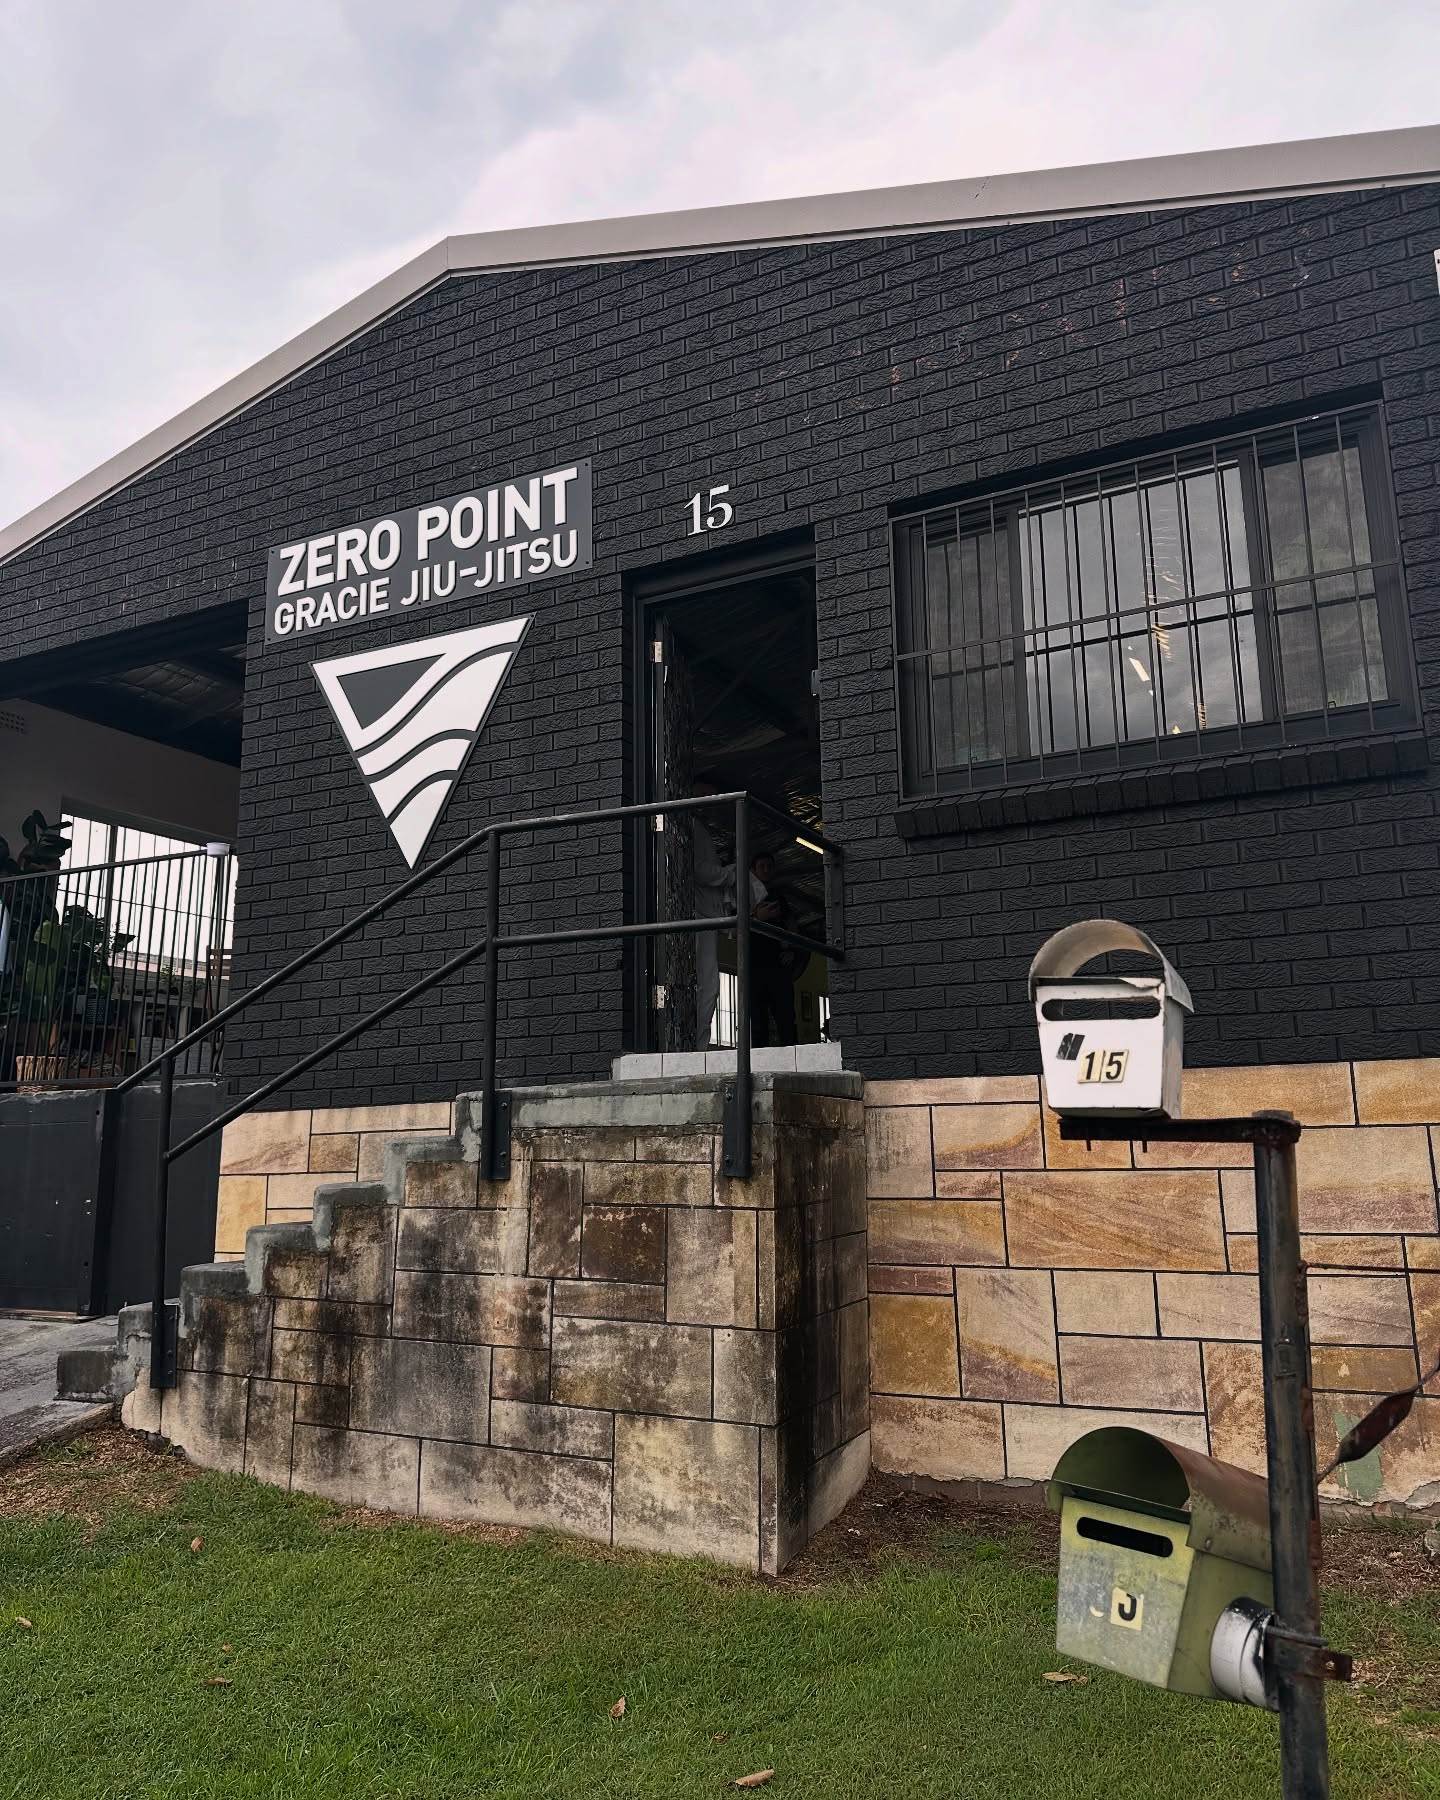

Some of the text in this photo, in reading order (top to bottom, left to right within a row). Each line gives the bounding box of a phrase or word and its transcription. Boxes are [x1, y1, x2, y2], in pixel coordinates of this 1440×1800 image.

[277, 466, 578, 597] ZERO POINT
[683, 484, 733, 536] 15
[274, 529, 578, 635] GRACIE JIU-JITSU
[1085, 1051, 1124, 1080] 15
